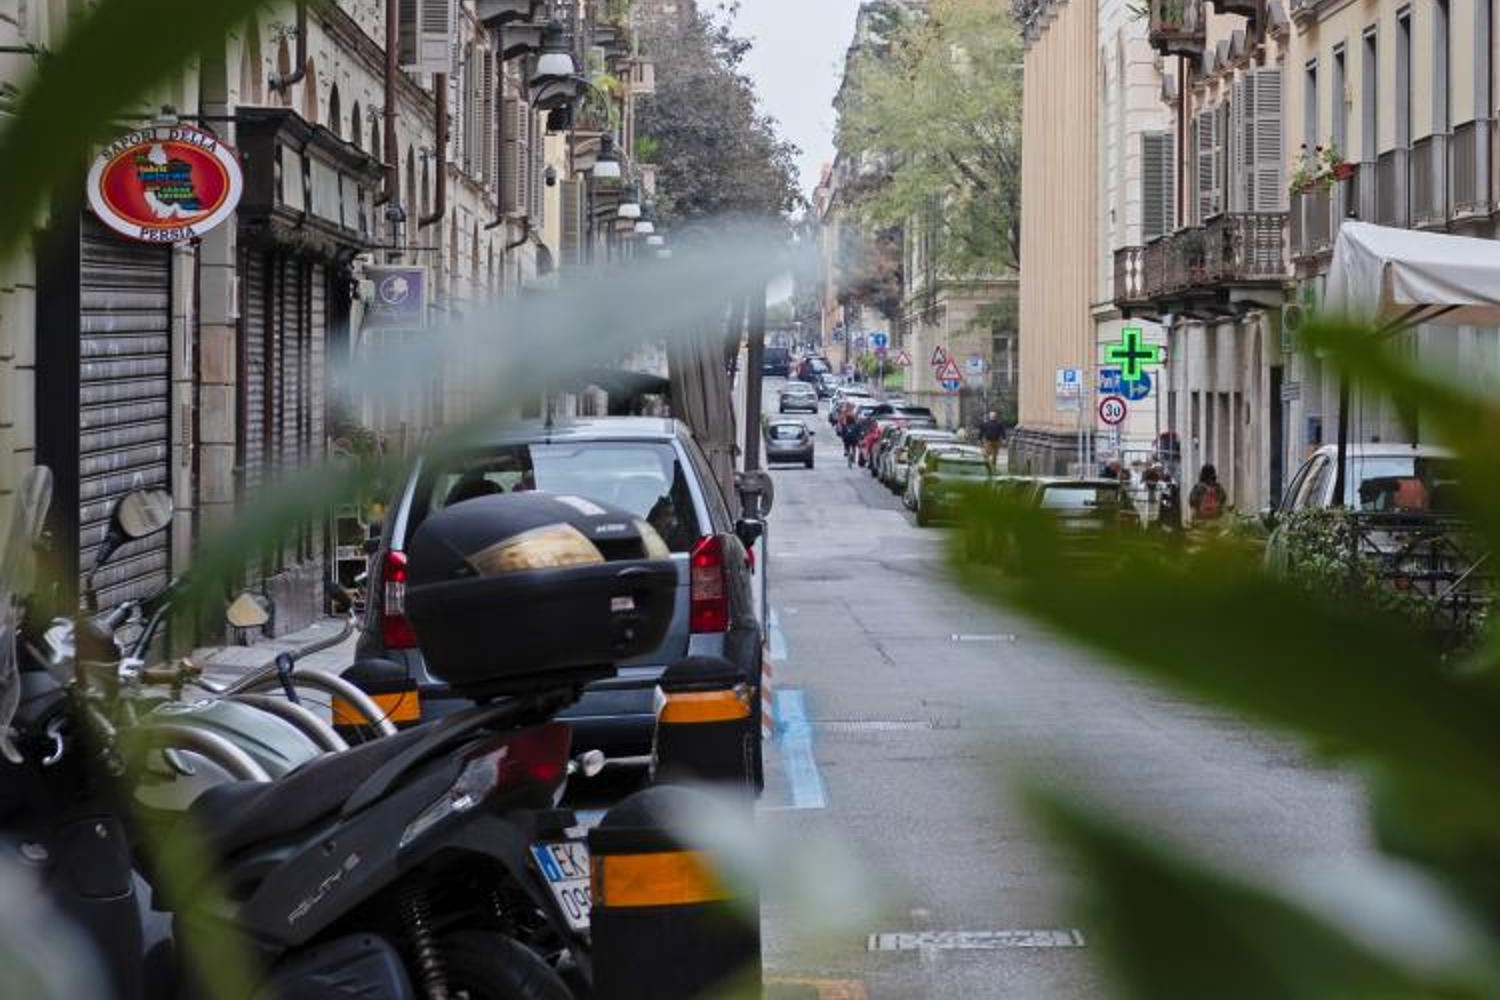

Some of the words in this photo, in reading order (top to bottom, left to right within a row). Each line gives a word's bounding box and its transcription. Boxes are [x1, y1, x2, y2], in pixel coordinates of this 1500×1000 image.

[102, 128, 157, 160] SAPORI
[168, 129, 218, 152] DELLA
[139, 227, 196, 241] PERSIA
[1105, 403, 1120, 417] 30
